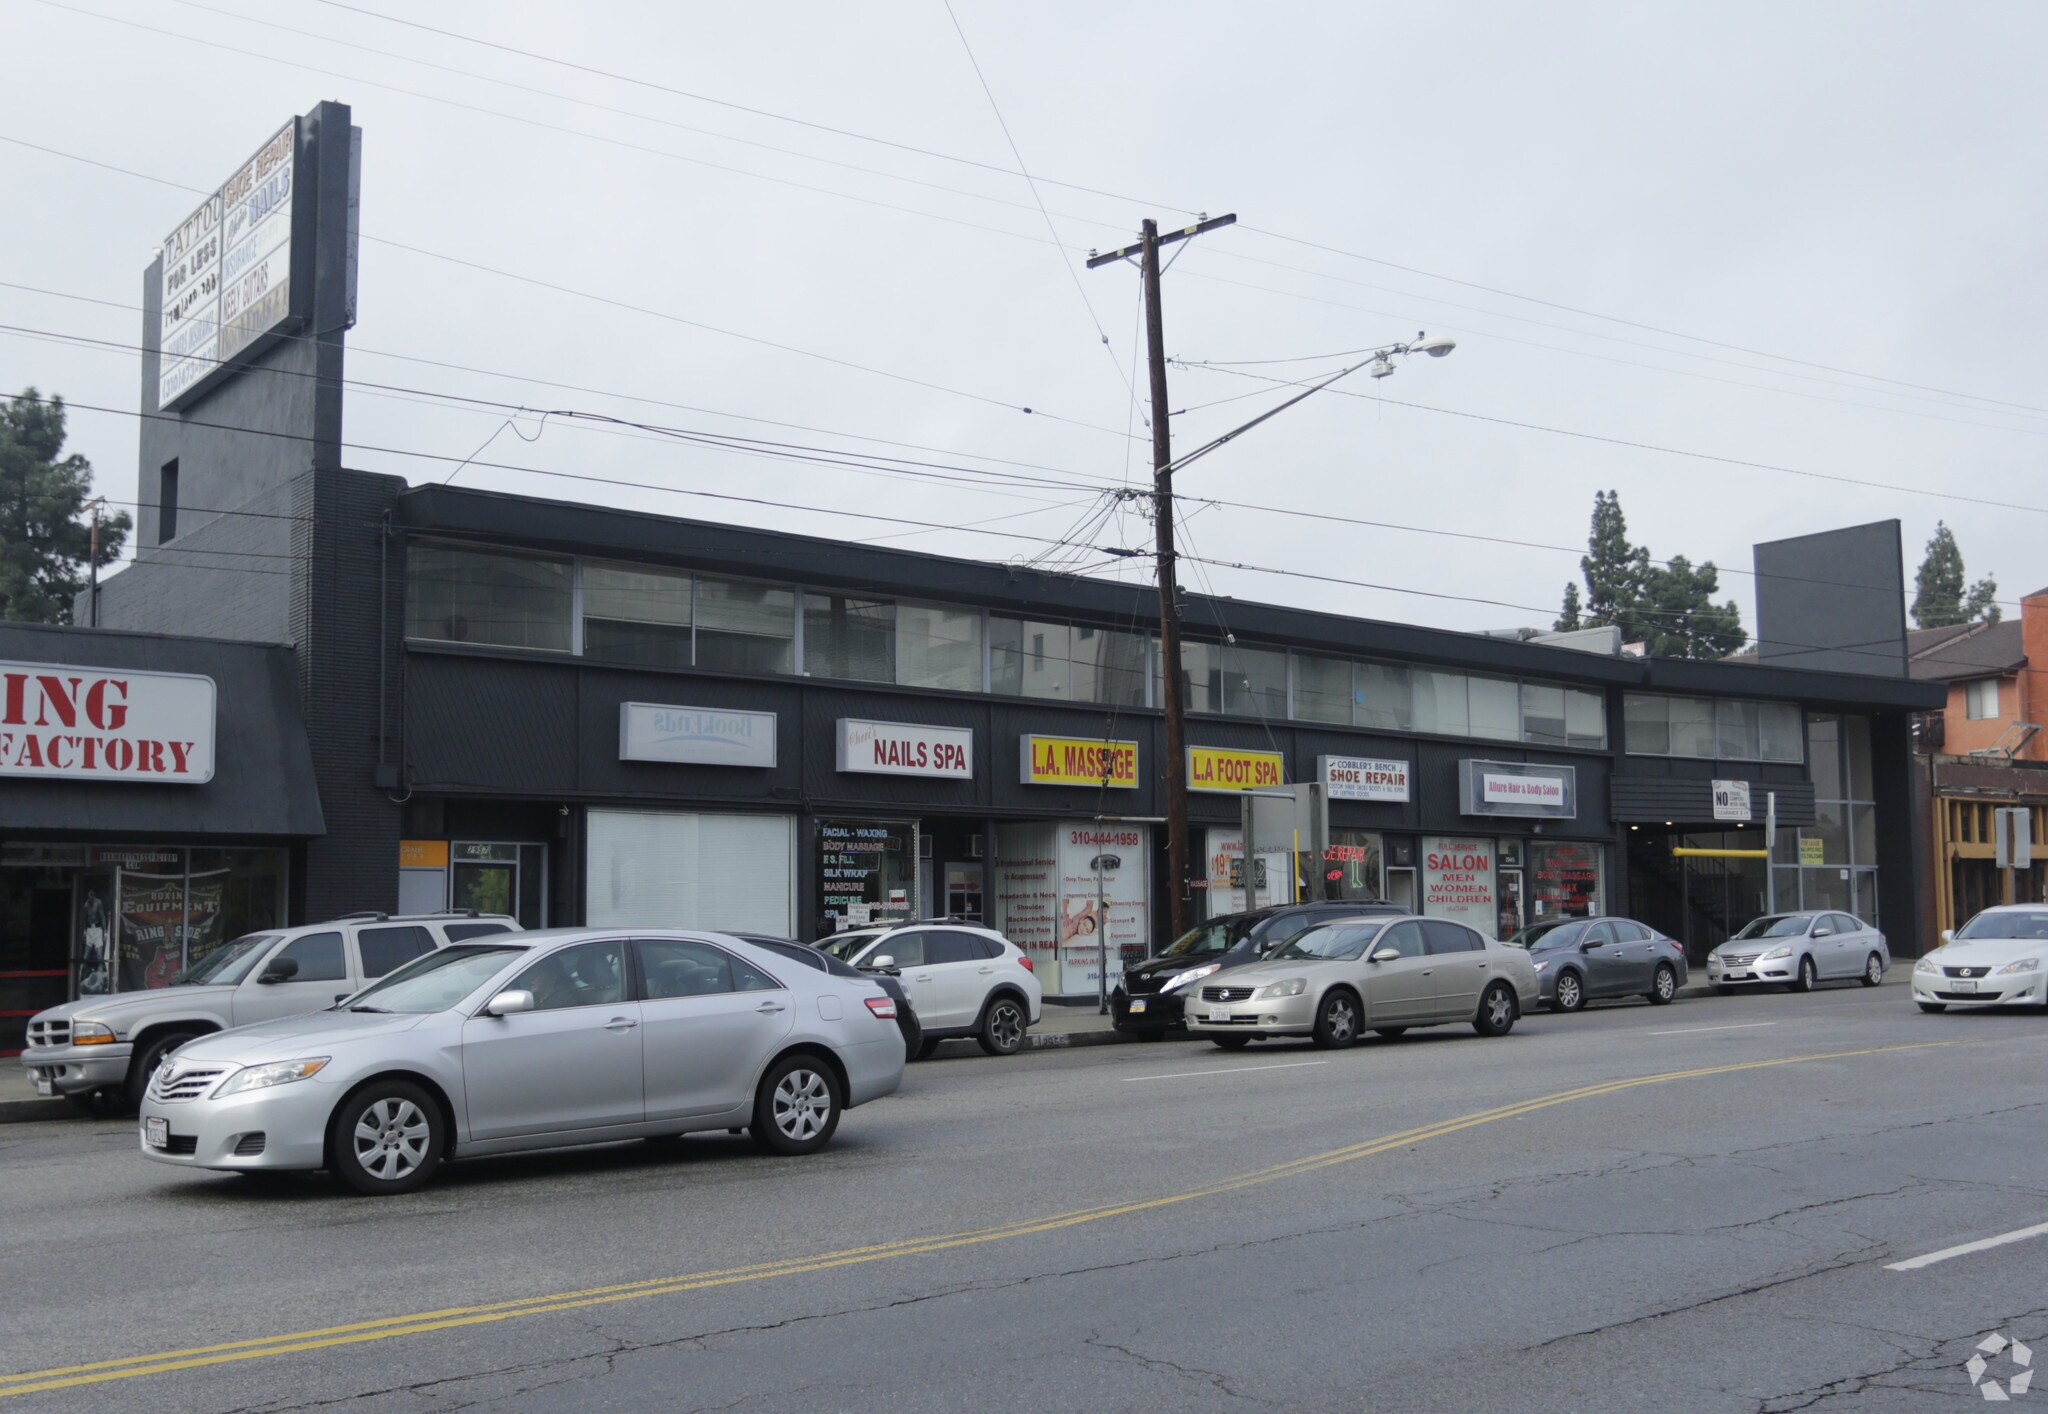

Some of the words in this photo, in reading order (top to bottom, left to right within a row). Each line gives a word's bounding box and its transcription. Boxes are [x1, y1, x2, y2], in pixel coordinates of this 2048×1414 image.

[225, 164, 253, 209] SHOE
[255, 127, 294, 180] REPAIR
[249, 167, 290, 227] NAILS
[165, 195, 221, 266] TATTOO
[190, 236, 217, 276] LESS
[1, 673, 129, 731] ING
[0, 733, 195, 774] FACTORY
[874, 738, 928, 769] NAILS
[933, 743, 967, 771] SPA
[1032, 743, 1060, 776] L.A.
[1217, 758, 1252, 784] FOOT
[1255, 761, 1279, 786] SPA
[1337, 760, 1372, 770] COBBLER'S
[1375, 762, 1396, 772] BENCH
[1330, 769, 1360, 784] SHOE
[1366, 771, 1406, 786] REPAIR
[1488, 781, 1508, 793] Allure
[1508, 782, 1521, 793] Hair
[1526, 784, 1542, 796] Body
[1542, 785, 1560, 796] Salon
[1715, 791, 1728, 807] NO
[822, 828, 850, 838] FACIAL
[856, 828, 888, 838] WAXING
[1071, 831, 1139, 847] 310-444-1958
[823, 841, 845, 851] BODY
[846, 842, 884, 853] MASSAGE
[1337, 845, 1366, 862] REPAIR
[838, 855, 855, 865] FILL
[1034, 858, 1057, 866] Service
[1427, 853, 1489, 872] SALON
[843, 868, 868, 878] WRAP
[1442, 873, 1475, 882] MEN
[1537, 870, 1559, 879] BODY
[1430, 884, 1488, 893] WOMEN
[1558, 883, 1578, 892] WAX
[151, 891, 186, 901] BOXIN
[824, 895, 863, 905] PEDICURE
[1427, 895, 1492, 904] CHILDREN
[824, 909, 840, 919] SPA
[175, 925, 202, 940] SDE
[1029, 941, 1038, 950] IN
